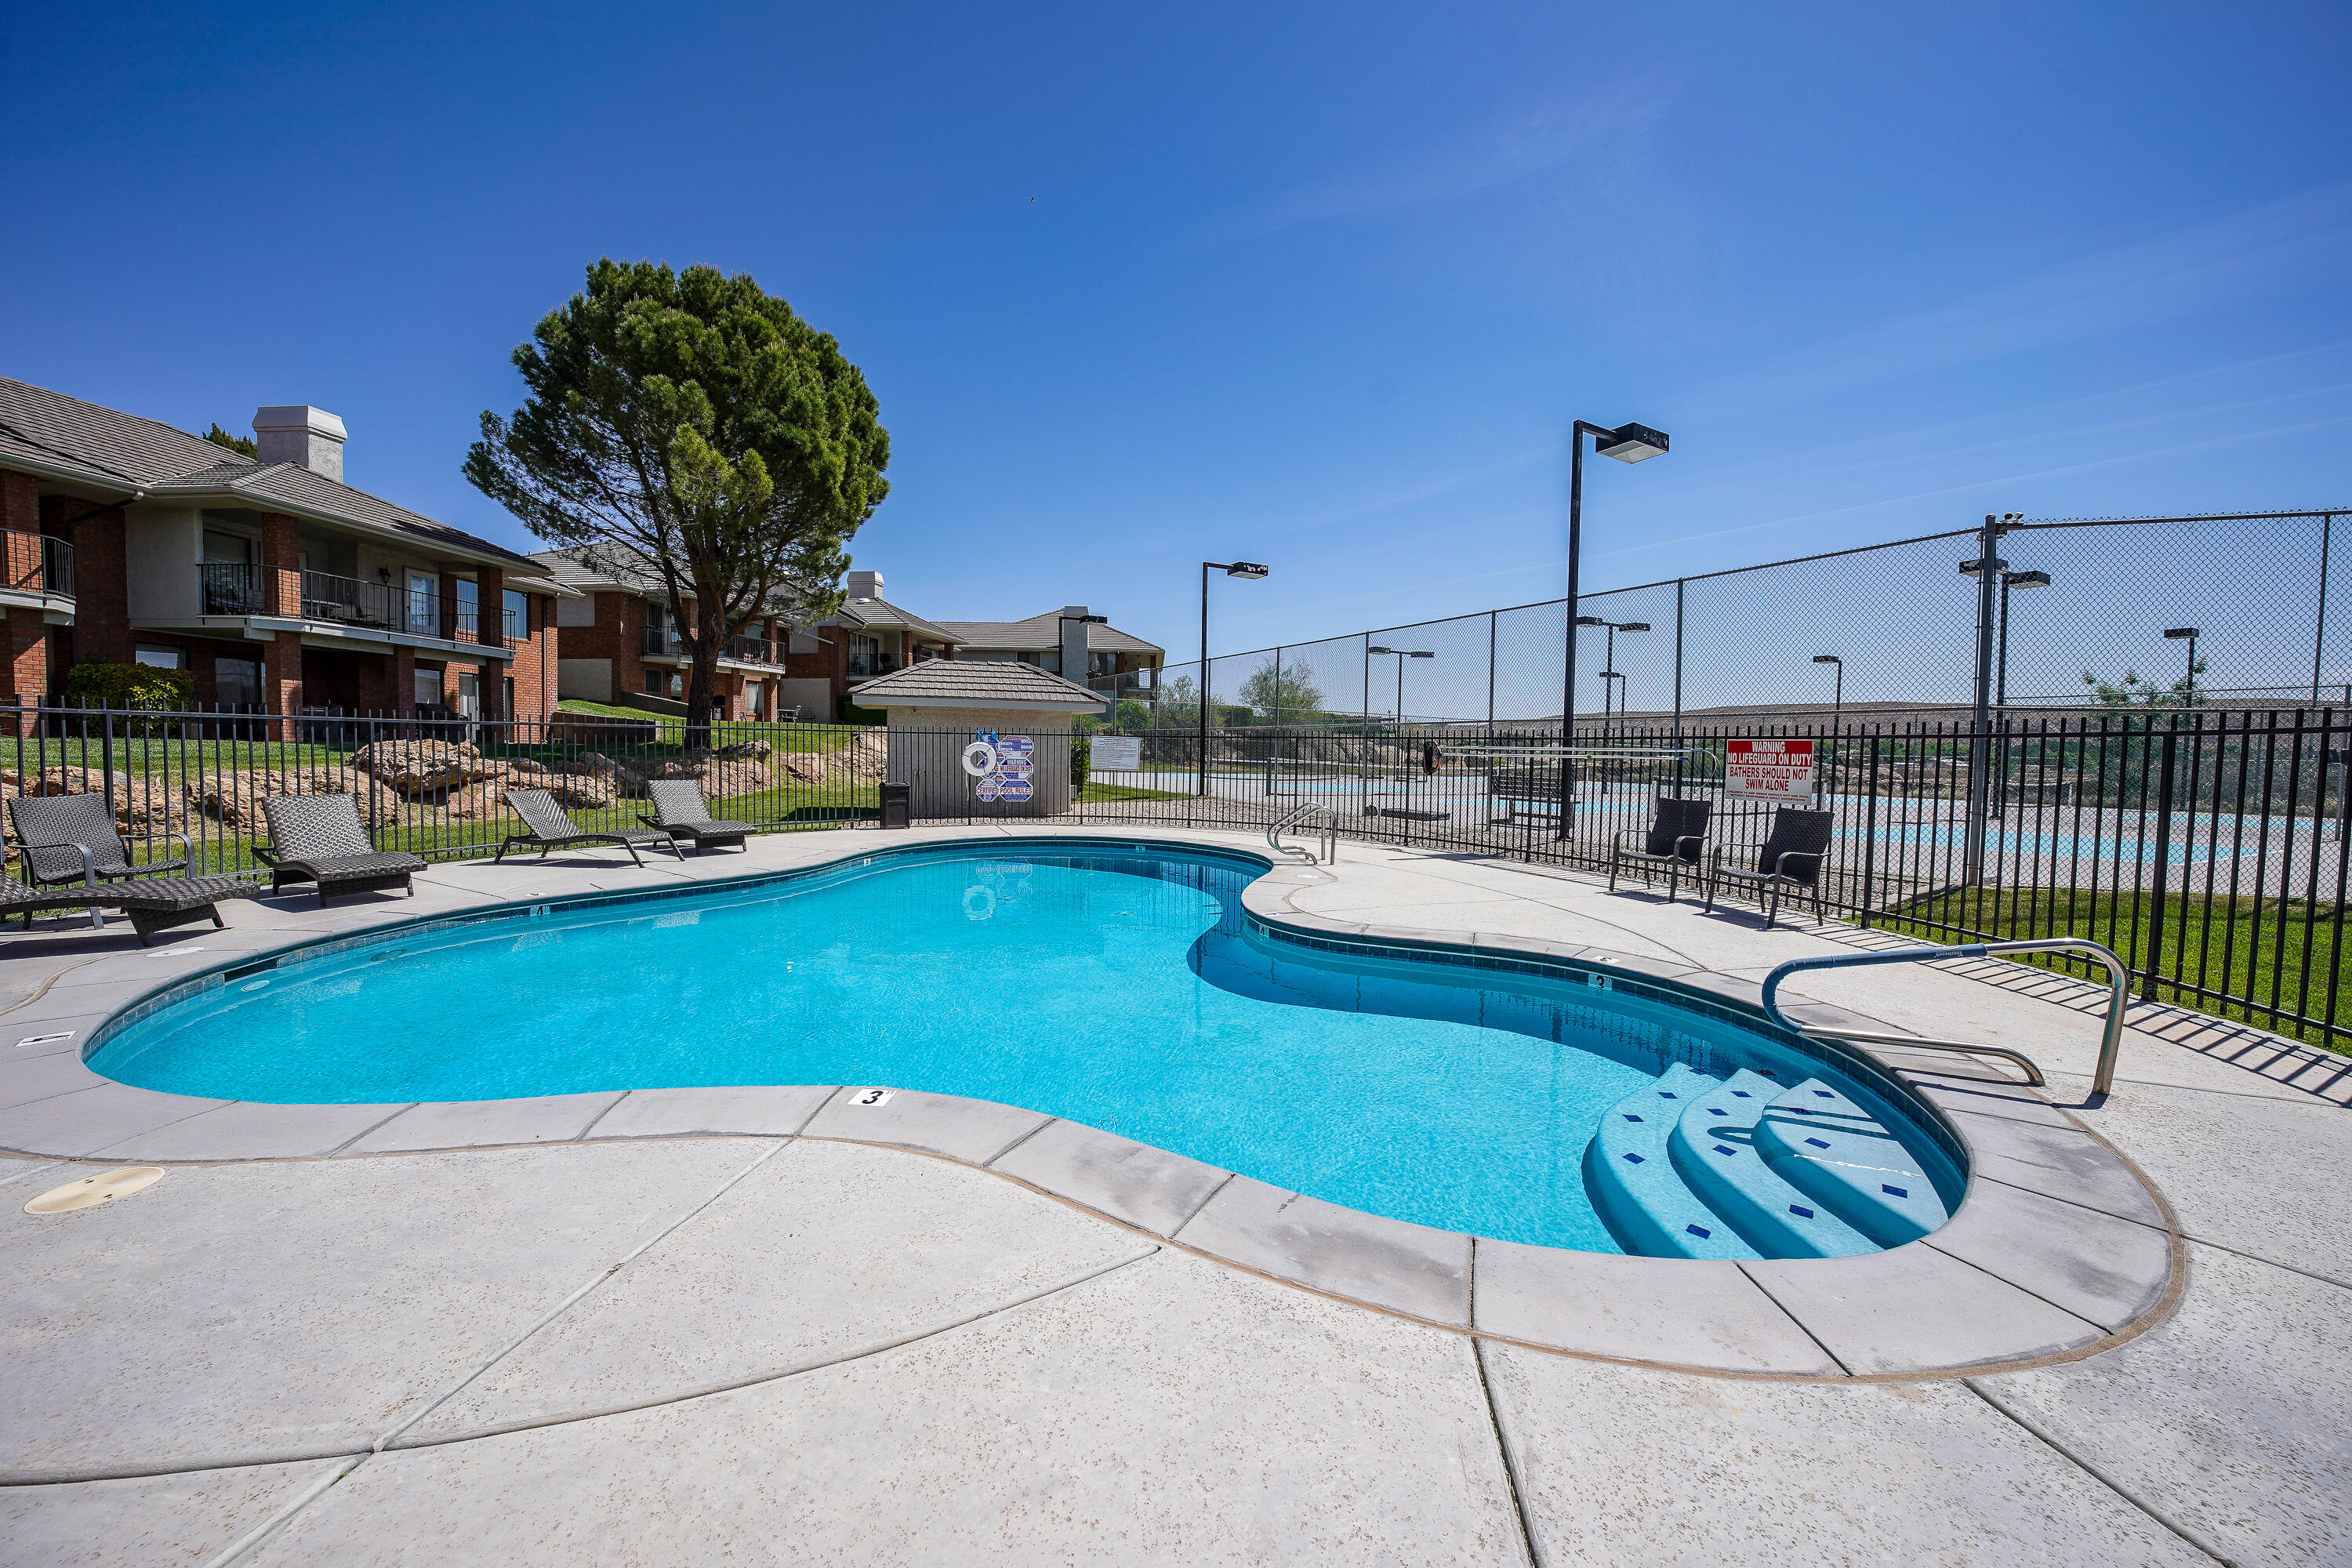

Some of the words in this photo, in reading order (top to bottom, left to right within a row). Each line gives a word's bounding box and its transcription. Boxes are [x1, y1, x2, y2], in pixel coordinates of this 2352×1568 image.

[1751, 741, 1785, 753] WARNING
[1727, 752, 1737, 764] NO
[1738, 753, 1777, 765] LIFEGUARD
[1778, 753, 1789, 765] ON
[1791, 753, 1812, 766] DUTY
[1730, 767, 1760, 779] BATHERS
[1761, 768, 1791, 779] SHOULD
[1792, 768, 1808, 781] NOT
[1745, 779, 1764, 790] SWIM
[1765, 779, 1789, 792] ALONE
[862, 1090, 884, 1105] 3
